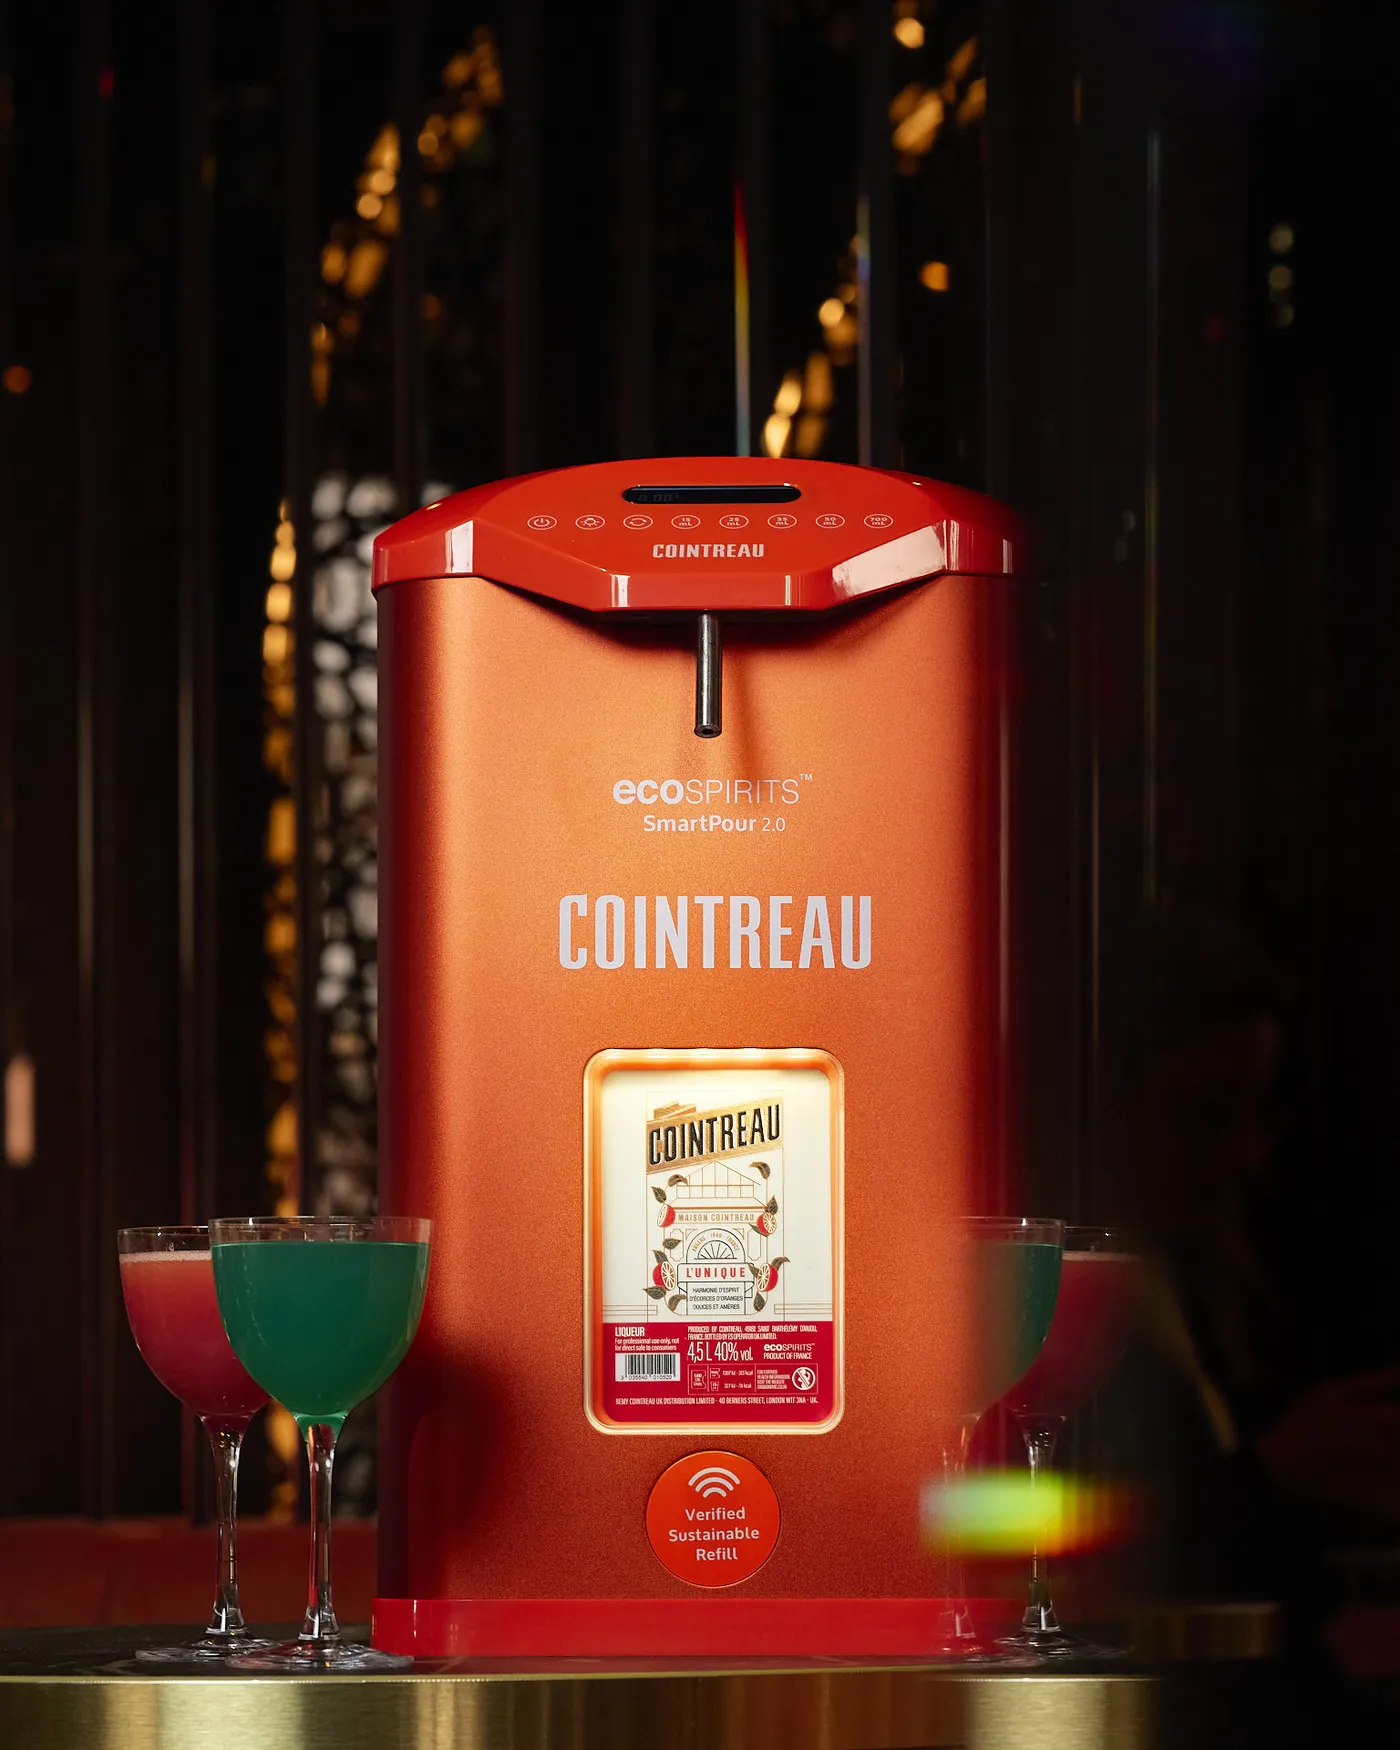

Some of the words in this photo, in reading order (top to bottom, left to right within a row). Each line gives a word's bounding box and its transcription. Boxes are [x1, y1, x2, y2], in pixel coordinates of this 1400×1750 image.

[652, 544, 765, 558] COINTREAU
[643, 815, 756, 832] SmartPour
[762, 817, 786, 832] 2.0
[559, 893, 872, 970] COINTREAU
[649, 1104, 780, 1166] COINTREAU
[678, 1214, 708, 1222] MAISON
[711, 1213, 754, 1221] COINTREAU
[686, 1268, 745, 1279] L'UNIQUE
[615, 1326, 645, 1337] LIQUEUR
[623, 1338, 651, 1346] professional
[687, 1342, 704, 1364] 4,5
[706, 1342, 712, 1361] L
[714, 1342, 739, 1361] 40%
[740, 1346, 754, 1361] vol.
[764, 1352, 786, 1360] PRODUCT
[786, 1352, 793, 1360] OF
[794, 1352, 812, 1360] FRANCE
[664, 1397, 695, 1405] DISTRIBUTION
[685, 1506, 745, 1521] Verified
[668, 1527, 760, 1542] Sustainable
[696, 1548, 738, 1561] Refill
